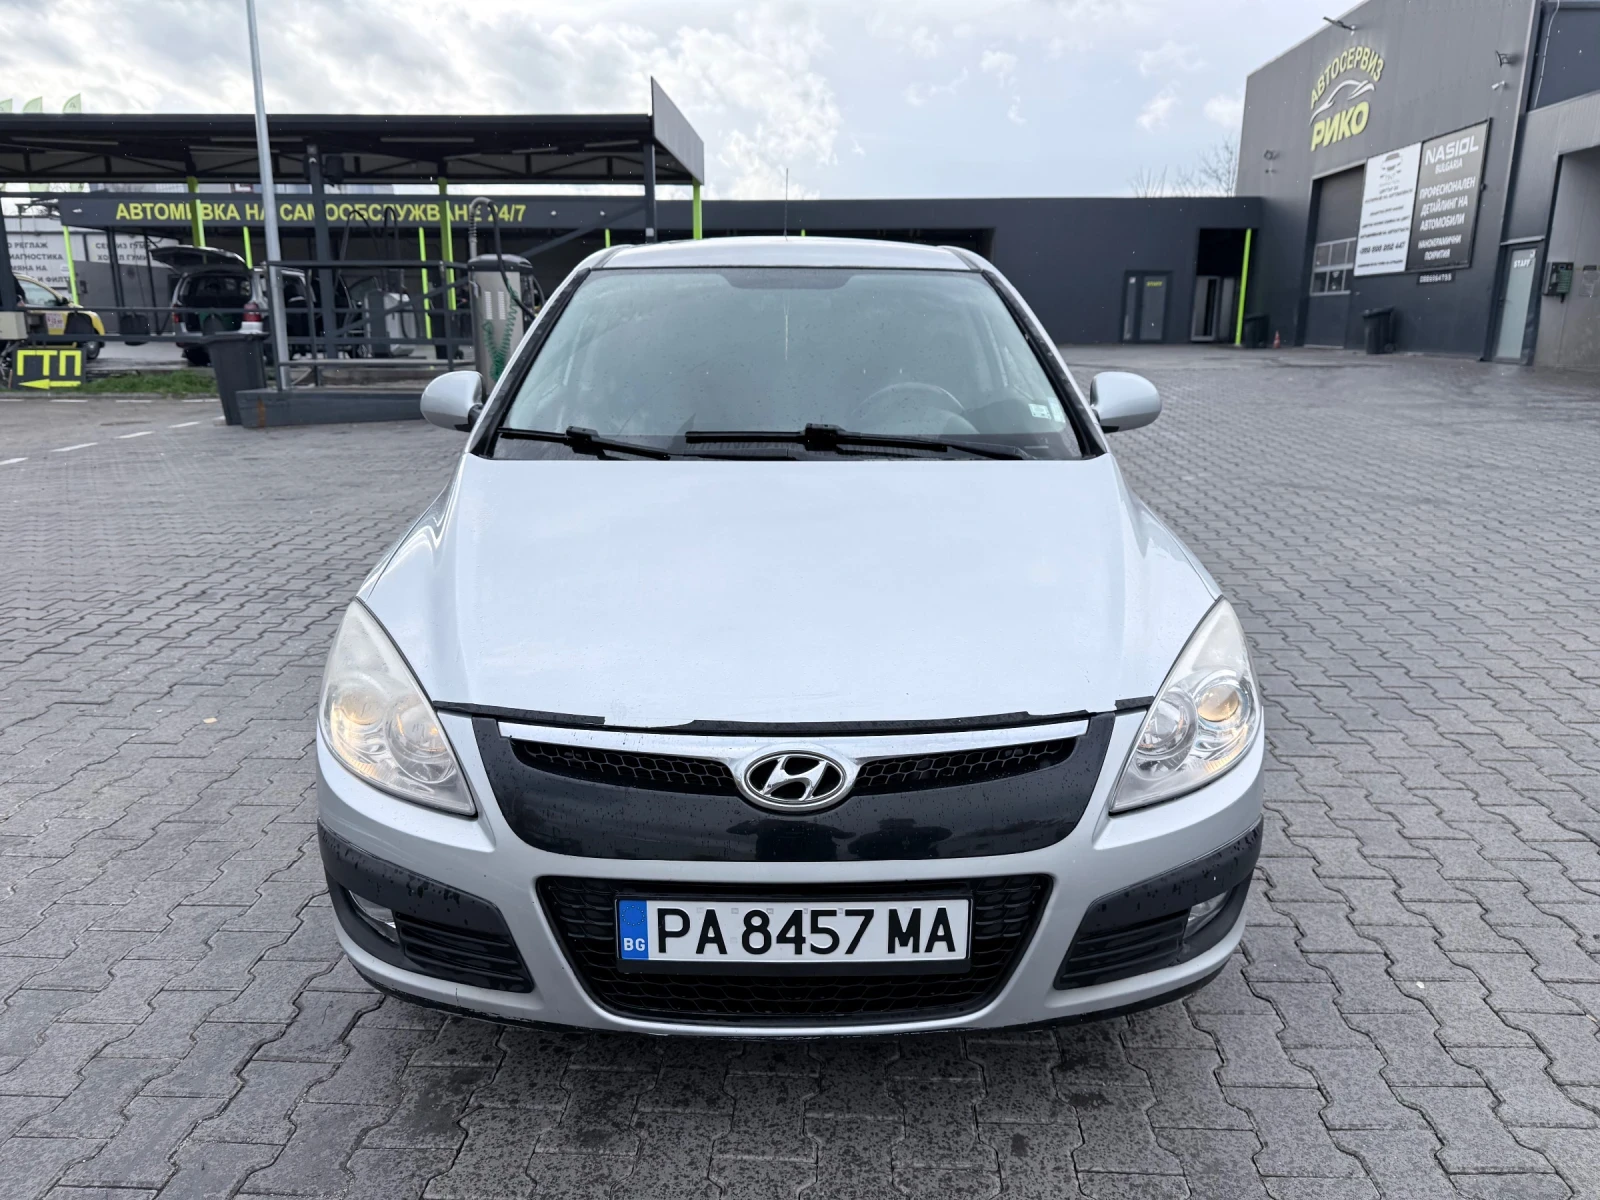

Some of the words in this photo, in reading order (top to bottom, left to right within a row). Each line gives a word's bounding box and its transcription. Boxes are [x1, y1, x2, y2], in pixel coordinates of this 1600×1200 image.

[1310, 46, 1384, 110] АВТОСЕРВИЗ
[1310, 101, 1370, 152] РИКО
[1424, 135, 1479, 166] NASIOL
[1434, 158, 1463, 174] BULGARIA
[1419, 176, 1476, 199] ПРОФЕСИОНАЛЕН
[1420, 197, 1458, 218] ДЕТАЙЛИНГ
[1457, 195, 1468, 208] НА
[1419, 212, 1466, 232] АВТОМОБИЛИ
[14, 241, 49, 249] РЕГЛАЖ
[95, 242, 128, 250] СЕИЗ
[10, 253, 64, 261] ИАГНОСТИКА
[36, 264, 48, 272] НА
[17, 350, 82, 376] ГТП
[656, 907, 728, 955] PA
[741, 908, 875, 956] 8457
[887, 907, 957, 954] MA
[623, 937, 646, 952] BG
